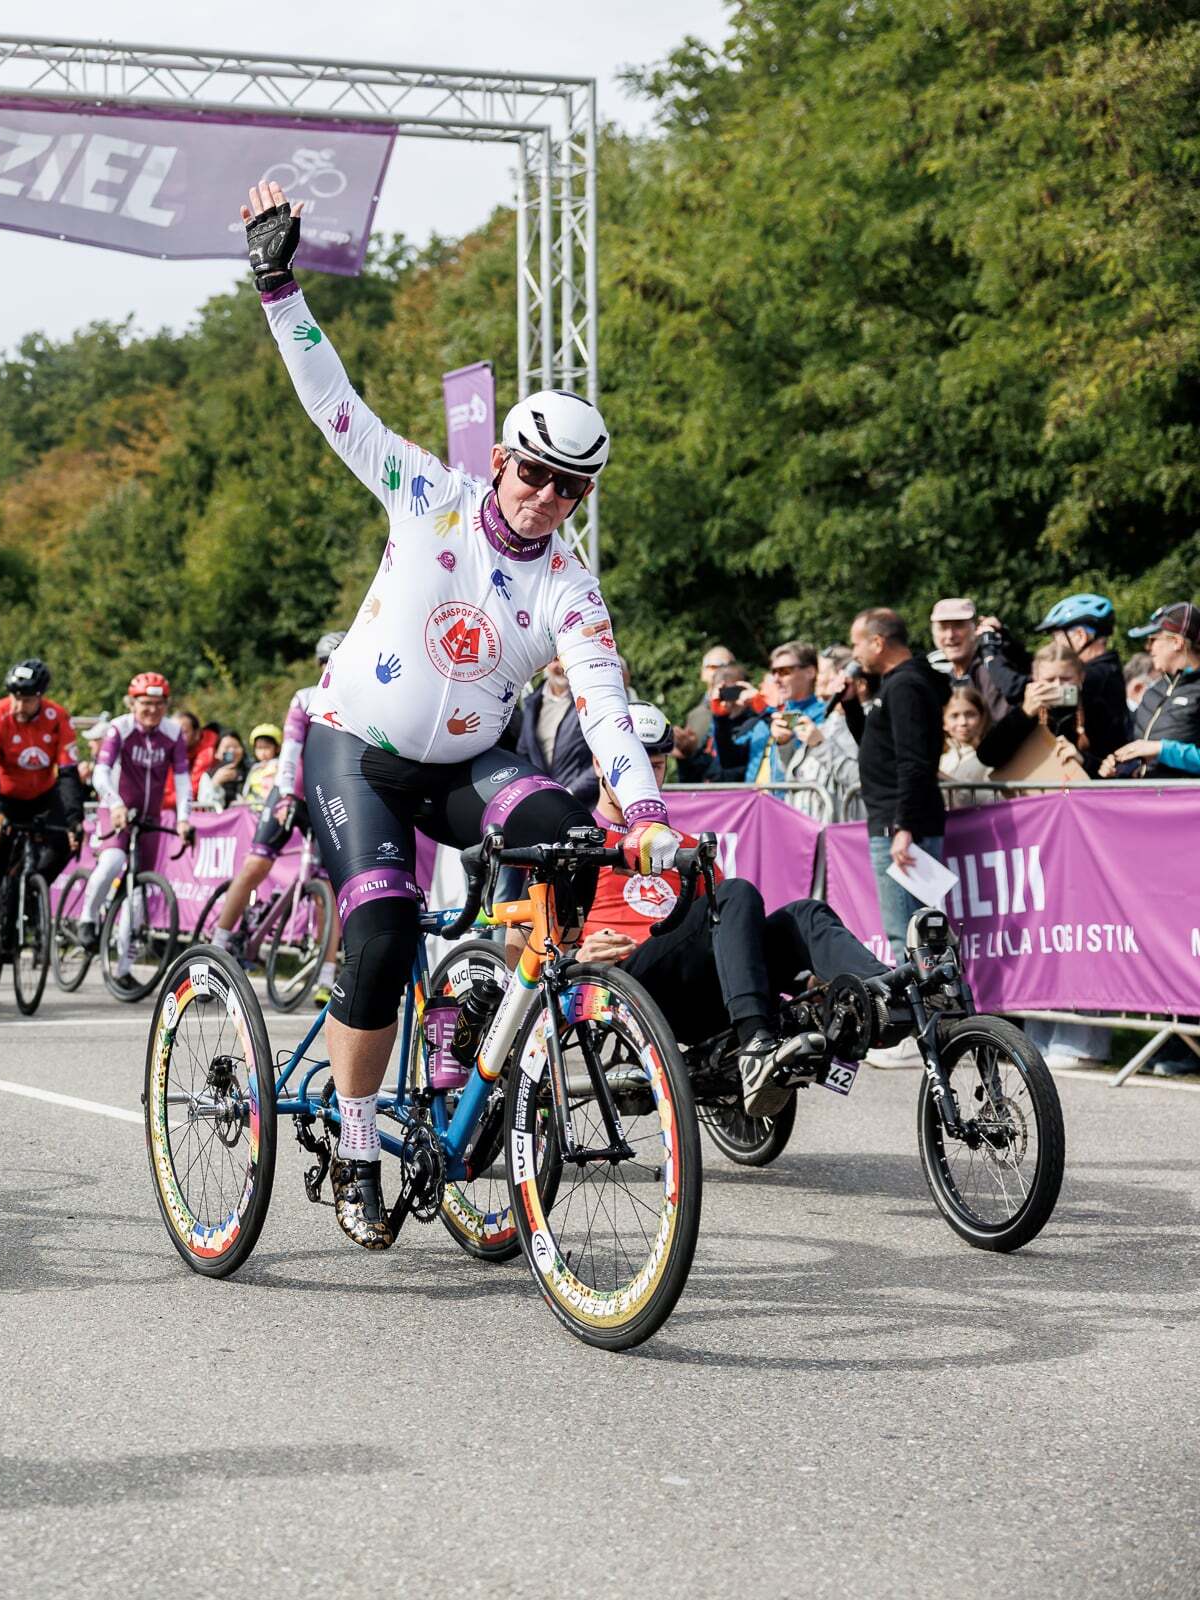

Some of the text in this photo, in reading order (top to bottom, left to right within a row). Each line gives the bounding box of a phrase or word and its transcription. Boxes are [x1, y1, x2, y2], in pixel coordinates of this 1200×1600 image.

[986, 927, 1033, 959] LILA
[1039, 923, 1140, 954] LOGISTIK
[195, 973, 208, 987] UCI
[455, 969, 469, 984] UCI
[828, 1067, 852, 1089] 42
[516, 1134, 527, 1170] UCI
